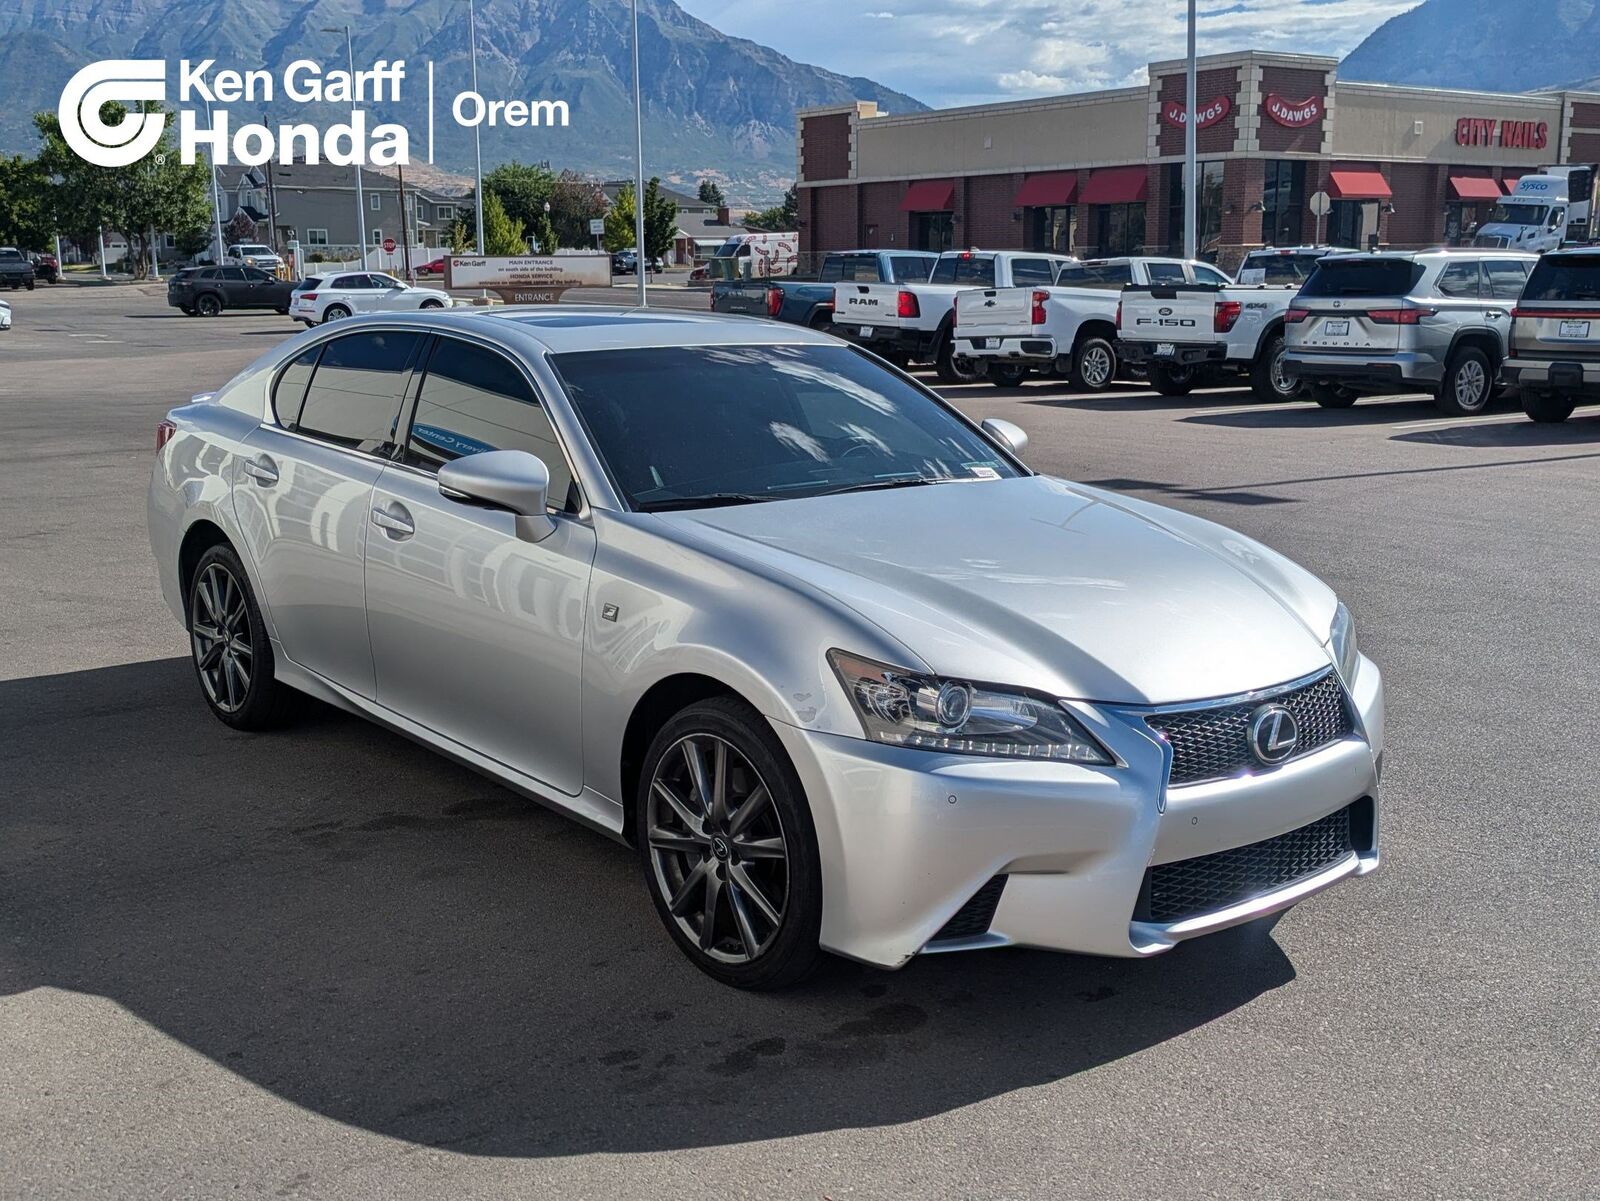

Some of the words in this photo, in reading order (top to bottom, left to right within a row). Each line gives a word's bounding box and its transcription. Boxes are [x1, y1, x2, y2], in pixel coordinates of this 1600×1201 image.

[1169, 103, 1222, 123] J.DWGS
[1456, 117, 1496, 146] CITY
[1500, 120, 1548, 150] NAILS
[514, 293, 554, 302] ENTRANCE
[848, 298, 879, 306] RAM
[1136, 318, 1195, 327] F-150
